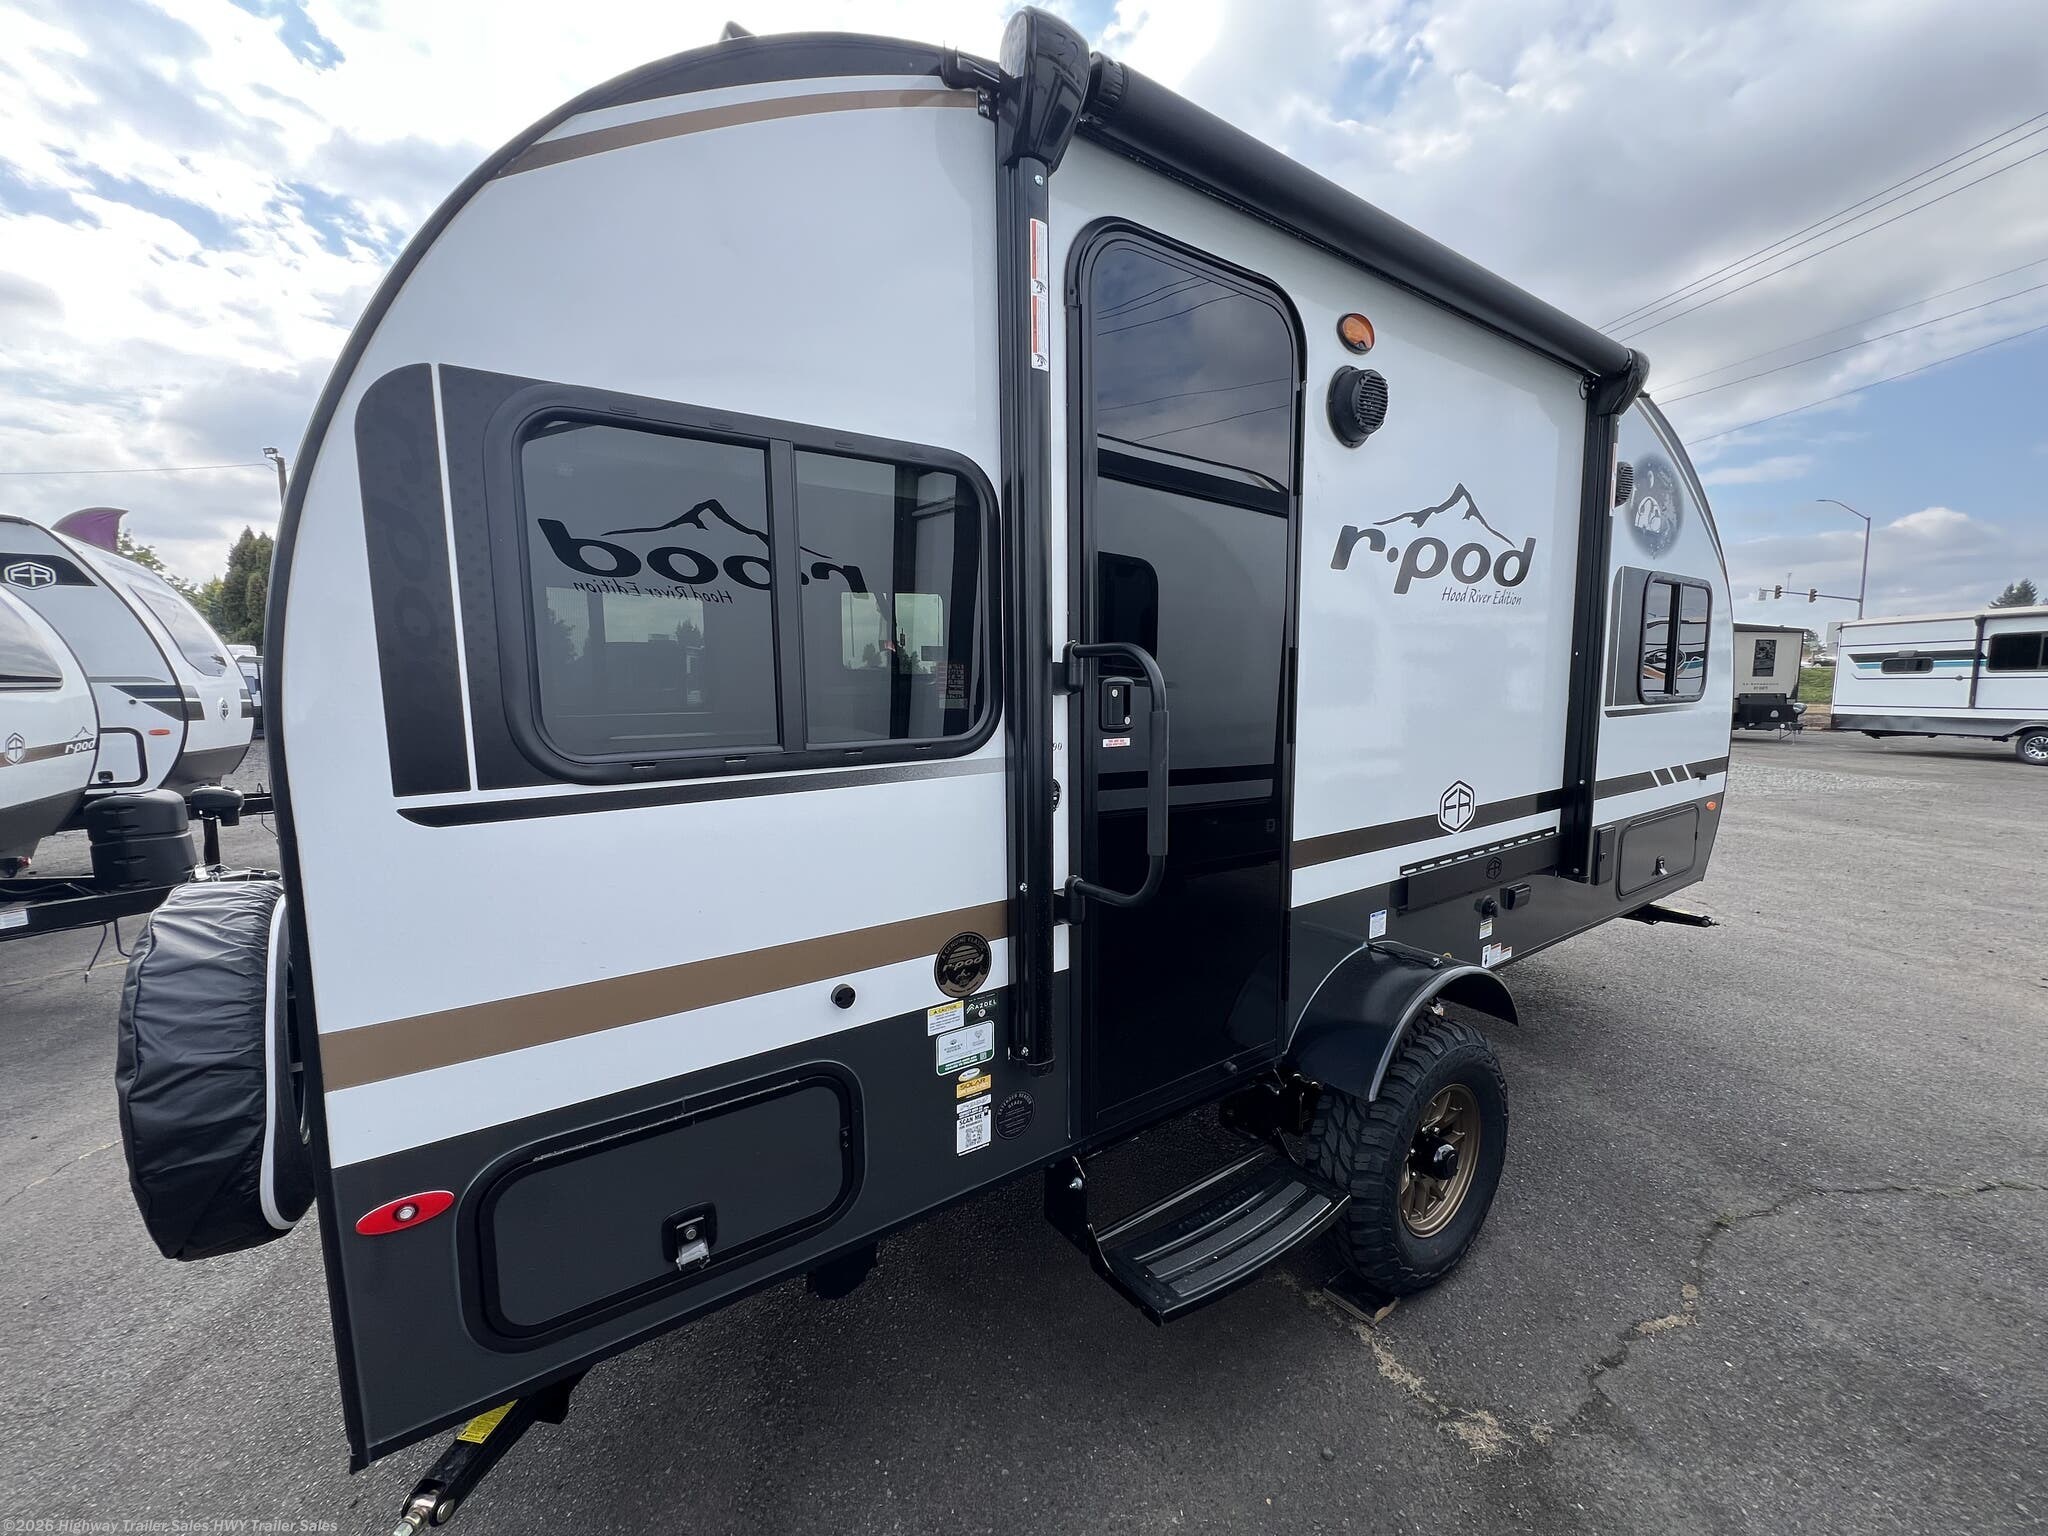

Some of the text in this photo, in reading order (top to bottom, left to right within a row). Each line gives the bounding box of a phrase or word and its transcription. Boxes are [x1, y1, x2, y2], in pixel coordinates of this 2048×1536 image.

[1441, 586, 1522, 606] Hood River Edition
[959, 1116, 974, 1126] SCAN
[974, 1113, 983, 1121] ME
